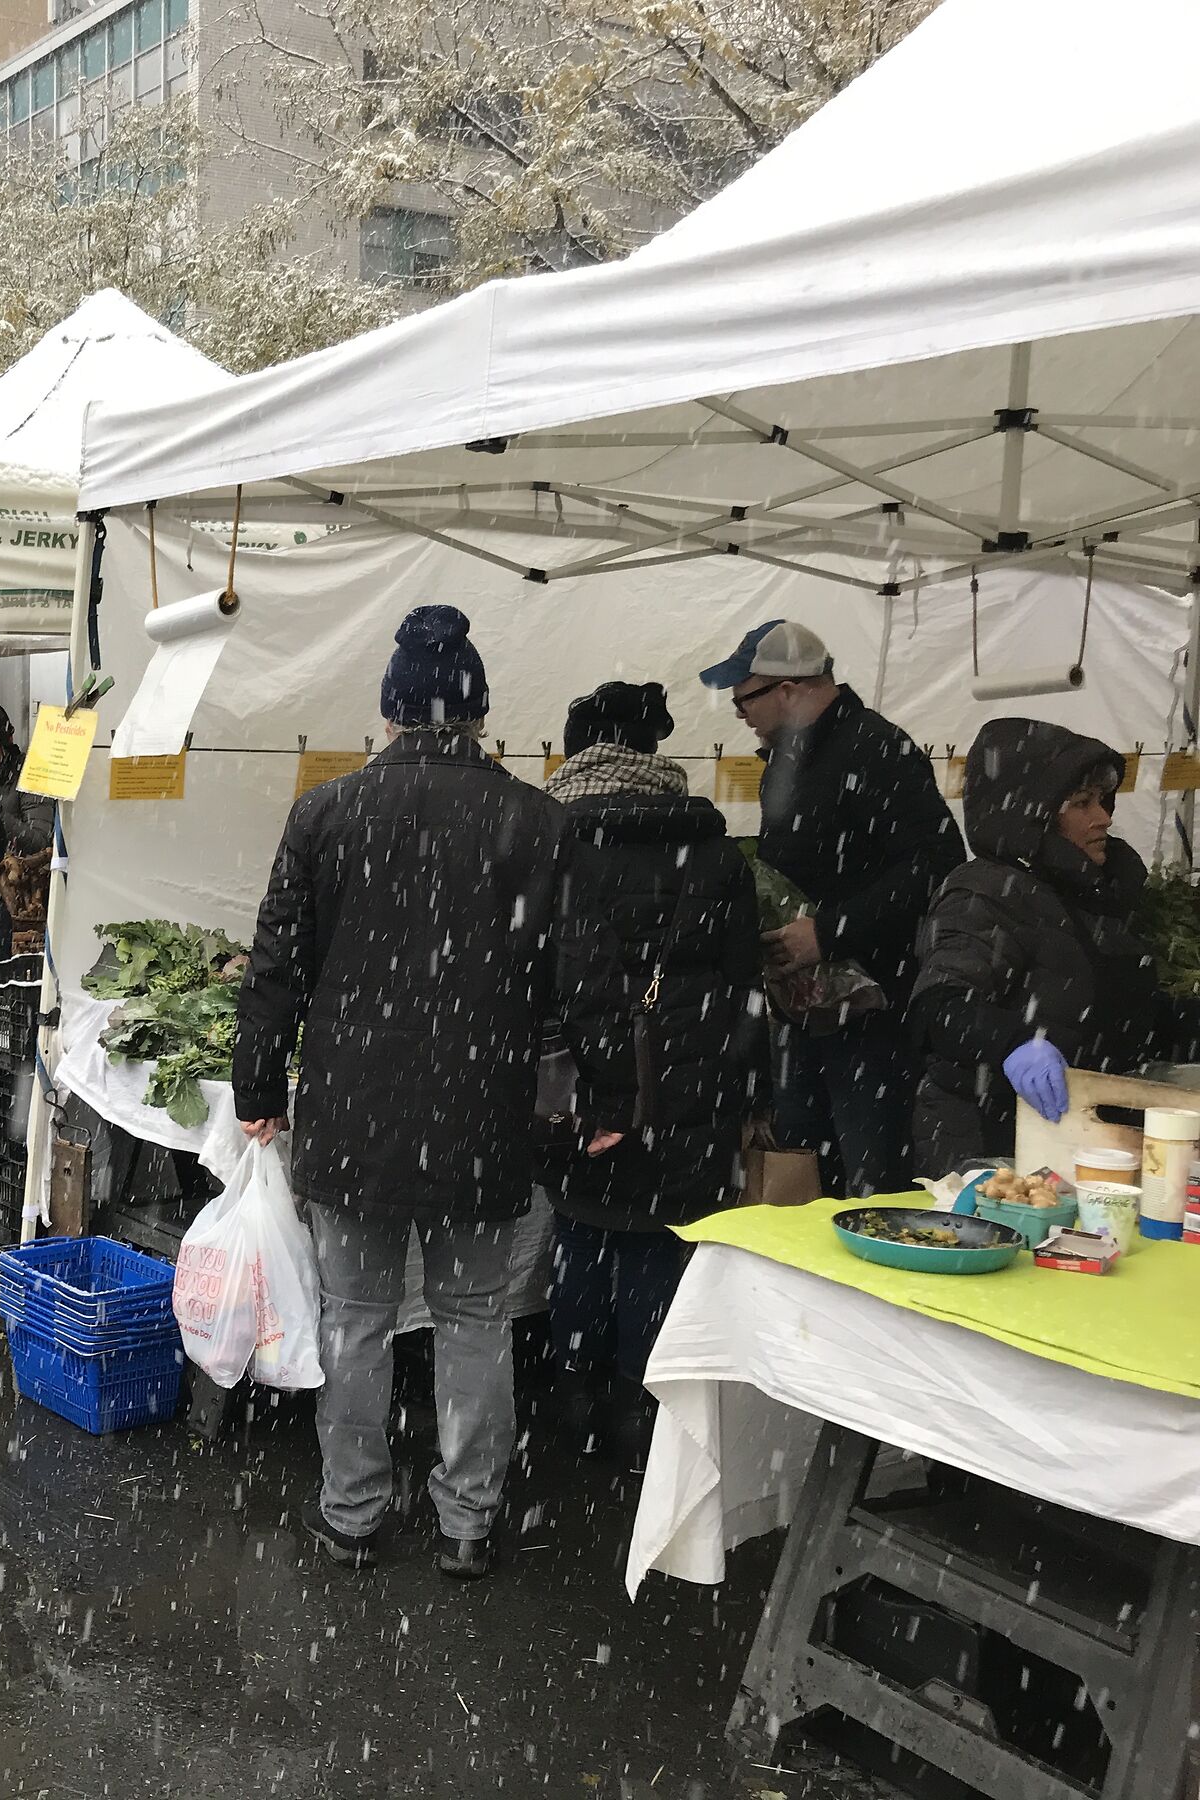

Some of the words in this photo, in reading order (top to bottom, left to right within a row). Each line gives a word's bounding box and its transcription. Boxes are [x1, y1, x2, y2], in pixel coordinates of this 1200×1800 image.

[10, 529, 79, 550] JERKY
[55, 721, 86, 737] Pesticides
[200, 1247, 227, 1272] YOU
[188, 1299, 216, 1326] YOU
